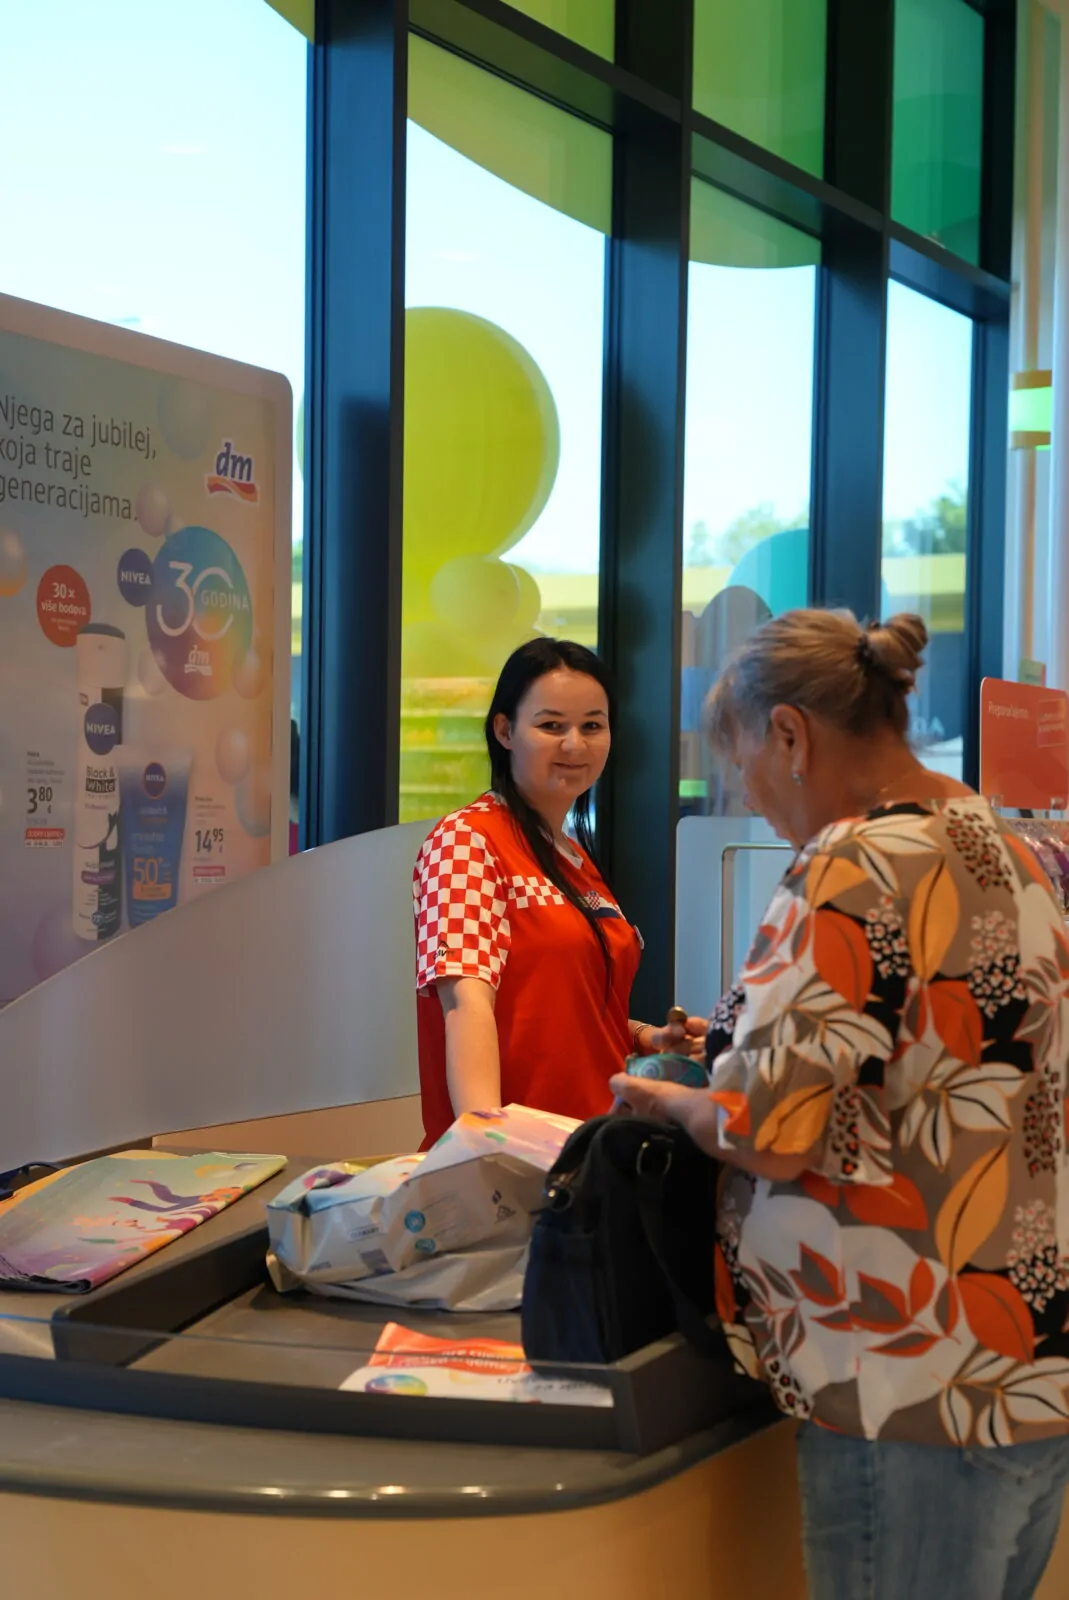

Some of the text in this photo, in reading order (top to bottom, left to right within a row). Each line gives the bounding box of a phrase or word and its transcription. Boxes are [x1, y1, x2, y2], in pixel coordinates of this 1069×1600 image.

[0, 395, 156, 460] Njega za jubilej,
[44, 442, 92, 480] traje
[216, 441, 252, 482] dm
[121, 570, 152, 585] NIVEA
[41, 600, 87, 616] više bodova
[201, 589, 250, 611] GODINA
[86, 722, 116, 735] NIVEA
[86, 765, 107, 778] Black
